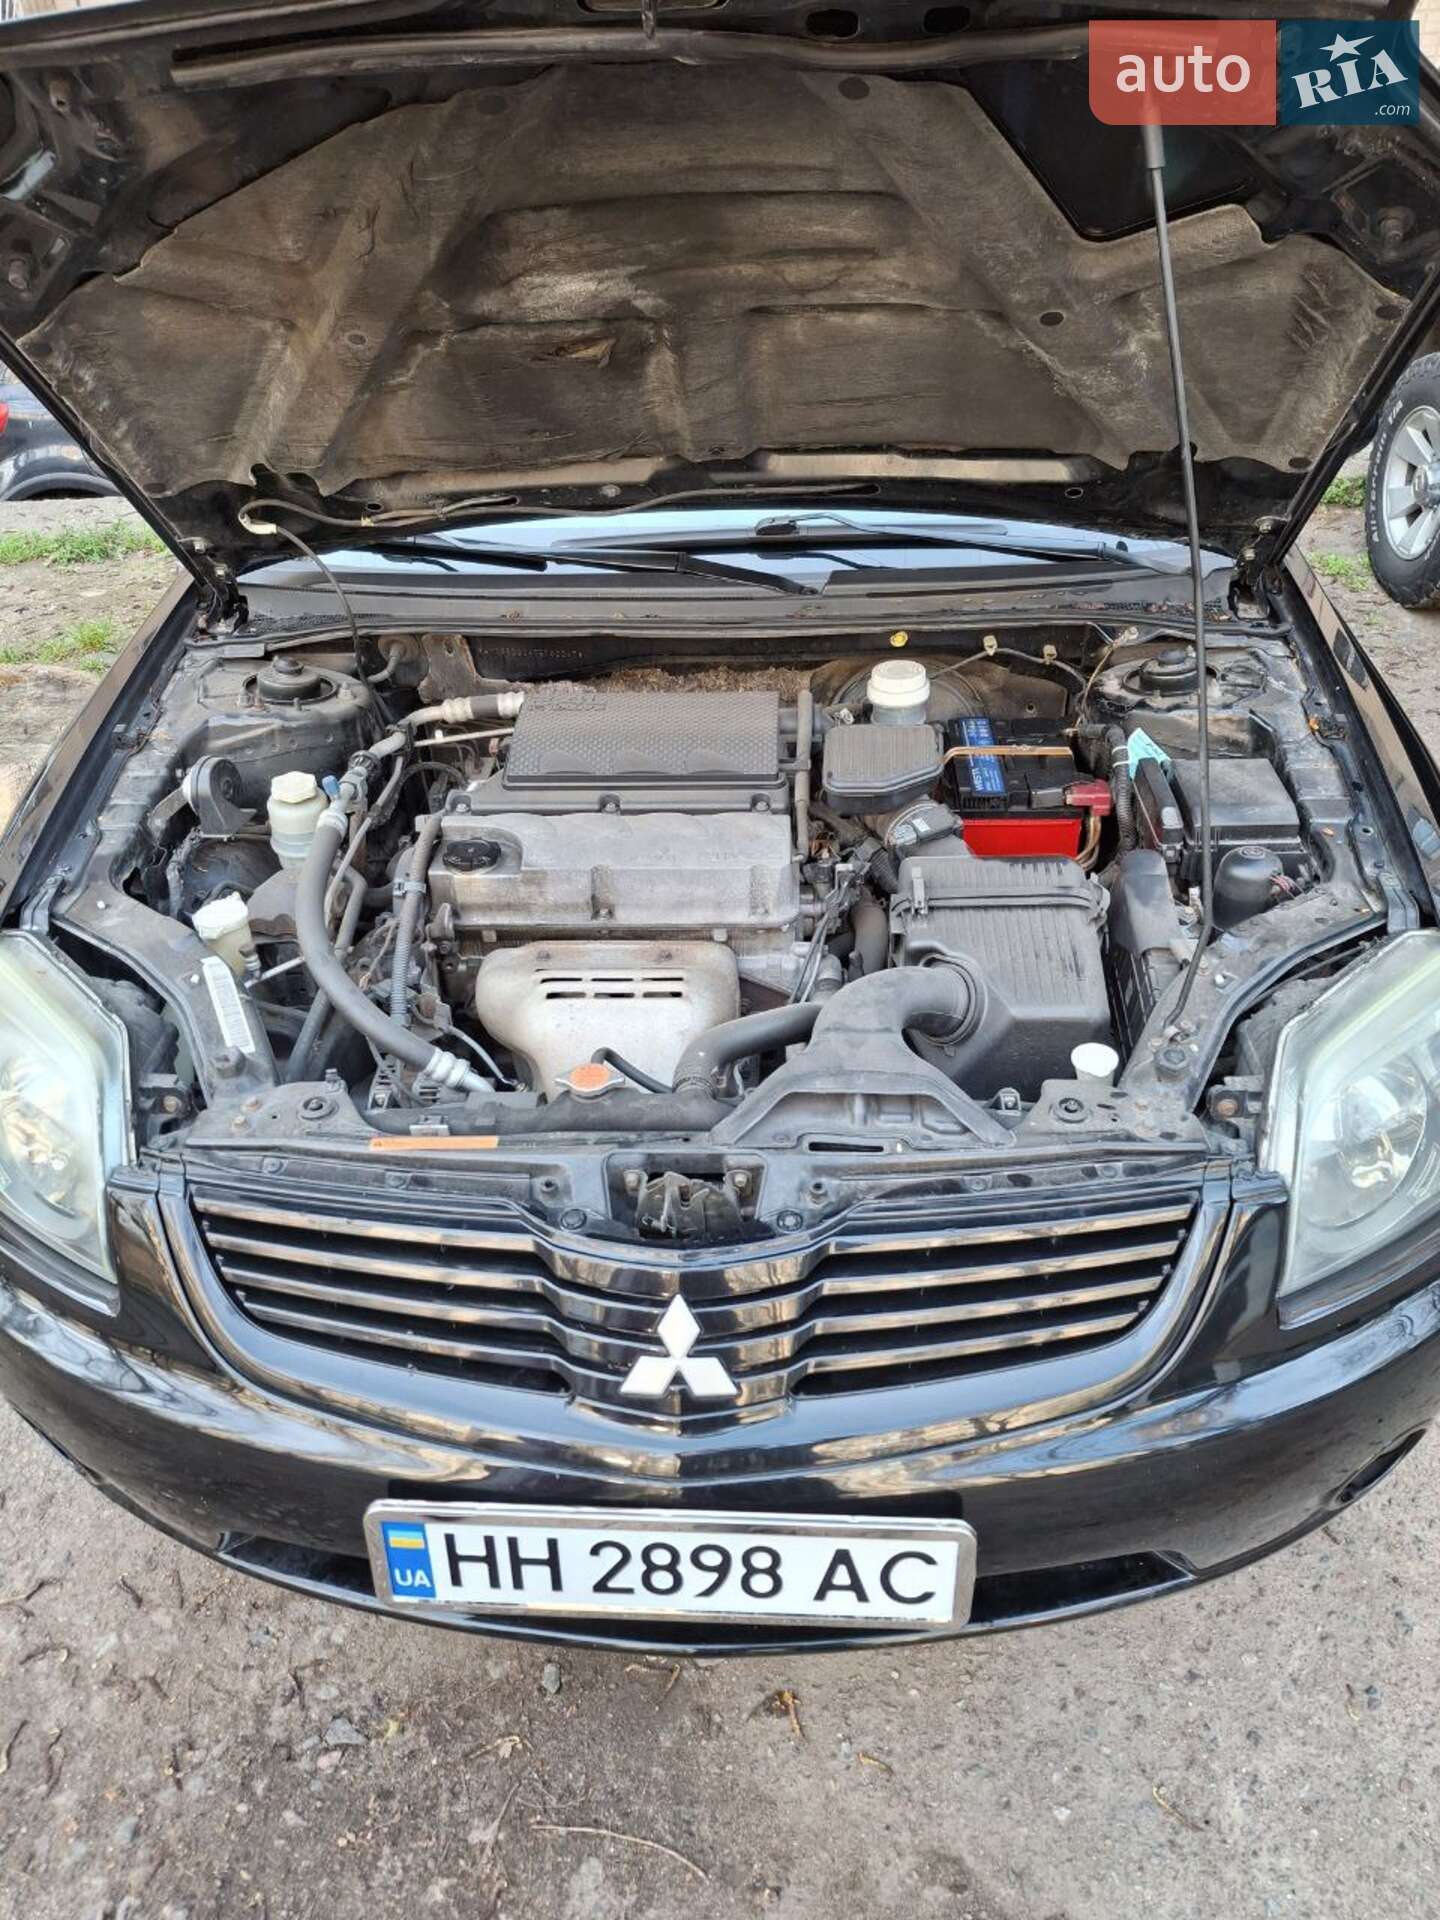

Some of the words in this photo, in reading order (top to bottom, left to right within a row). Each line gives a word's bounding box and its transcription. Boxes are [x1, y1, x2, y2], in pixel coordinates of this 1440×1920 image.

[395, 1569, 431, 1589] UA
[445, 1533, 563, 1592] HH
[589, 1540, 783, 1599] 2898
[814, 1548, 938, 1605] AC
